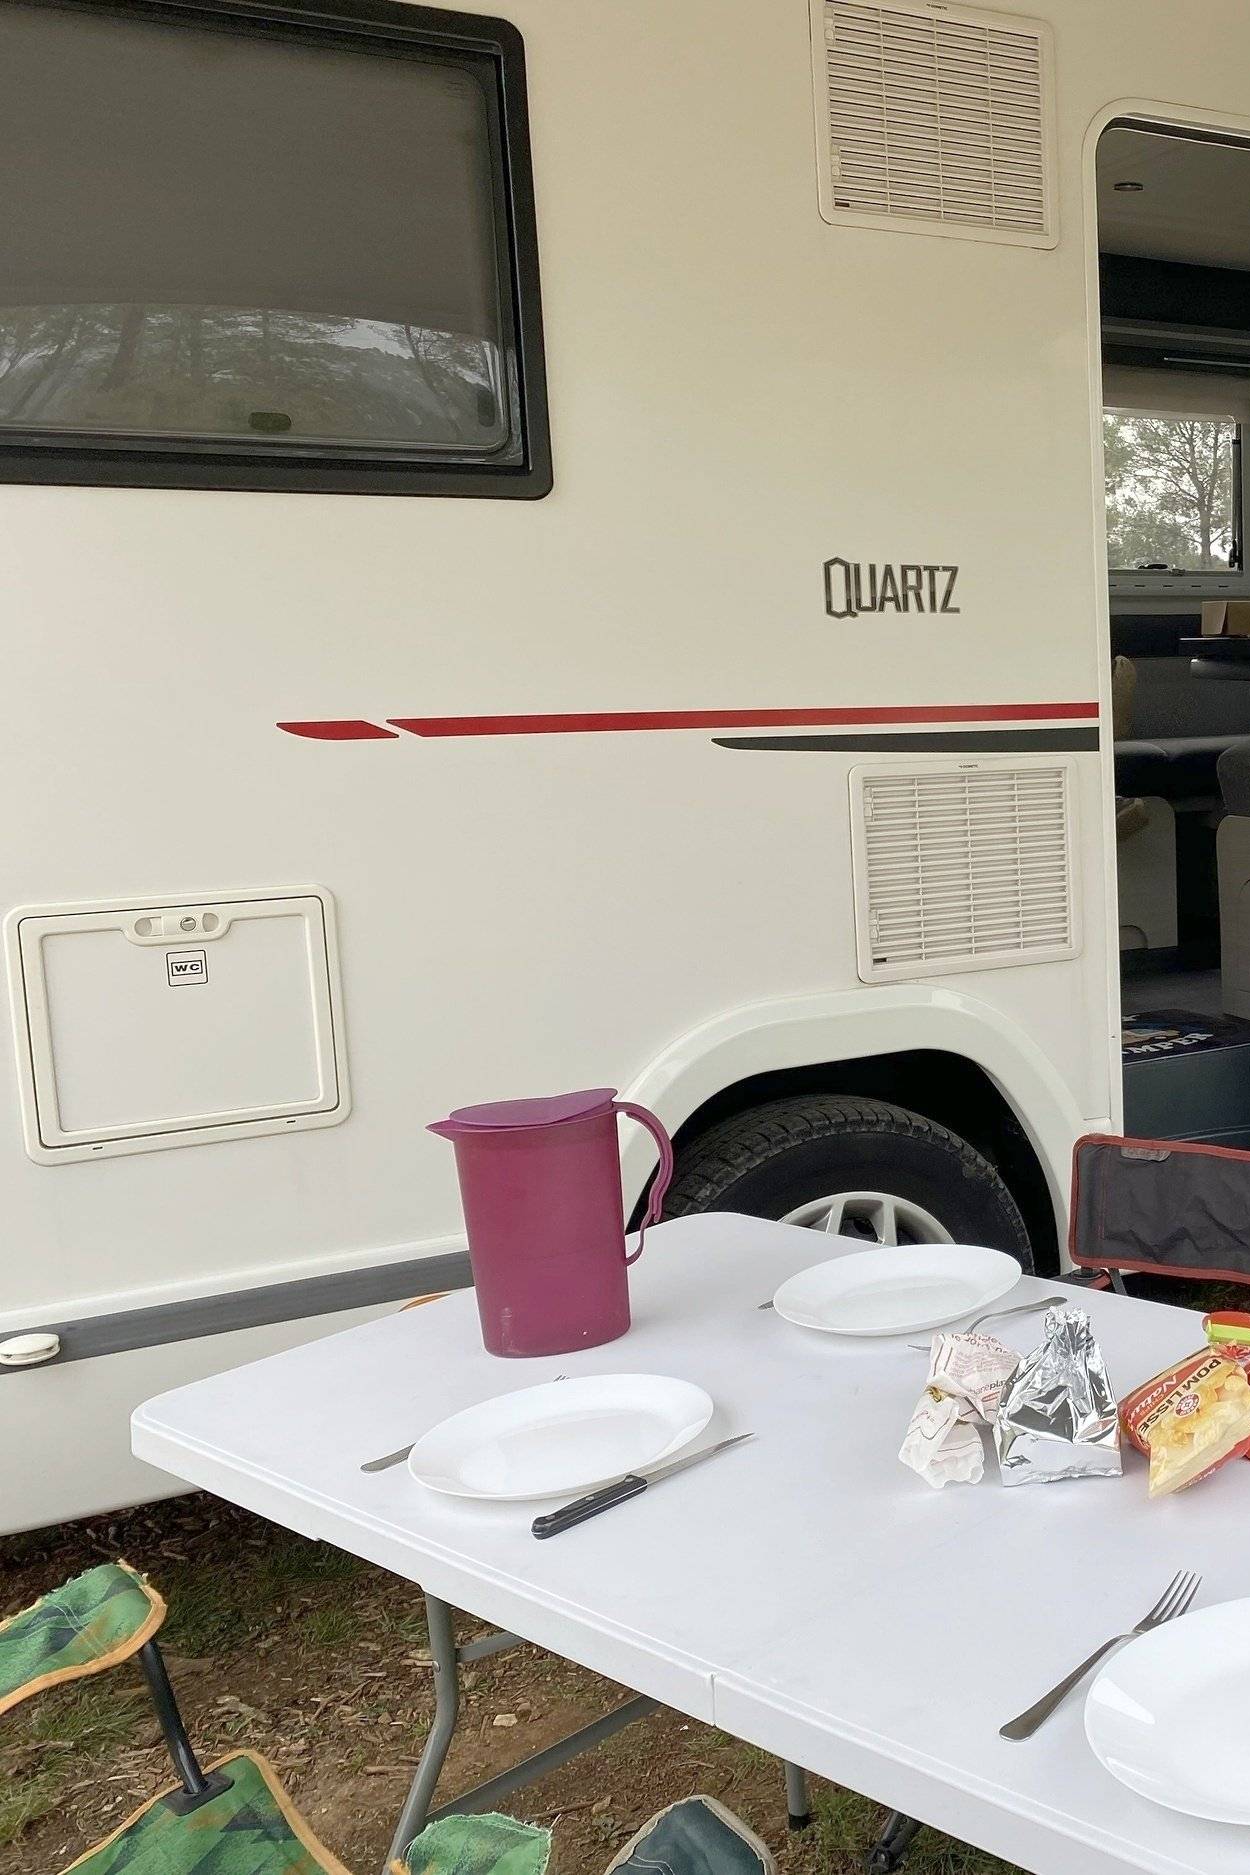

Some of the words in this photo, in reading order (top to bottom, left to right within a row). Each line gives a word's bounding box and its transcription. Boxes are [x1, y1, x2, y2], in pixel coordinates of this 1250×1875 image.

[823, 557, 961, 619] QUARTZ
[174, 963, 200, 973] WC
[1122, 1033, 1214, 1054] MPER
